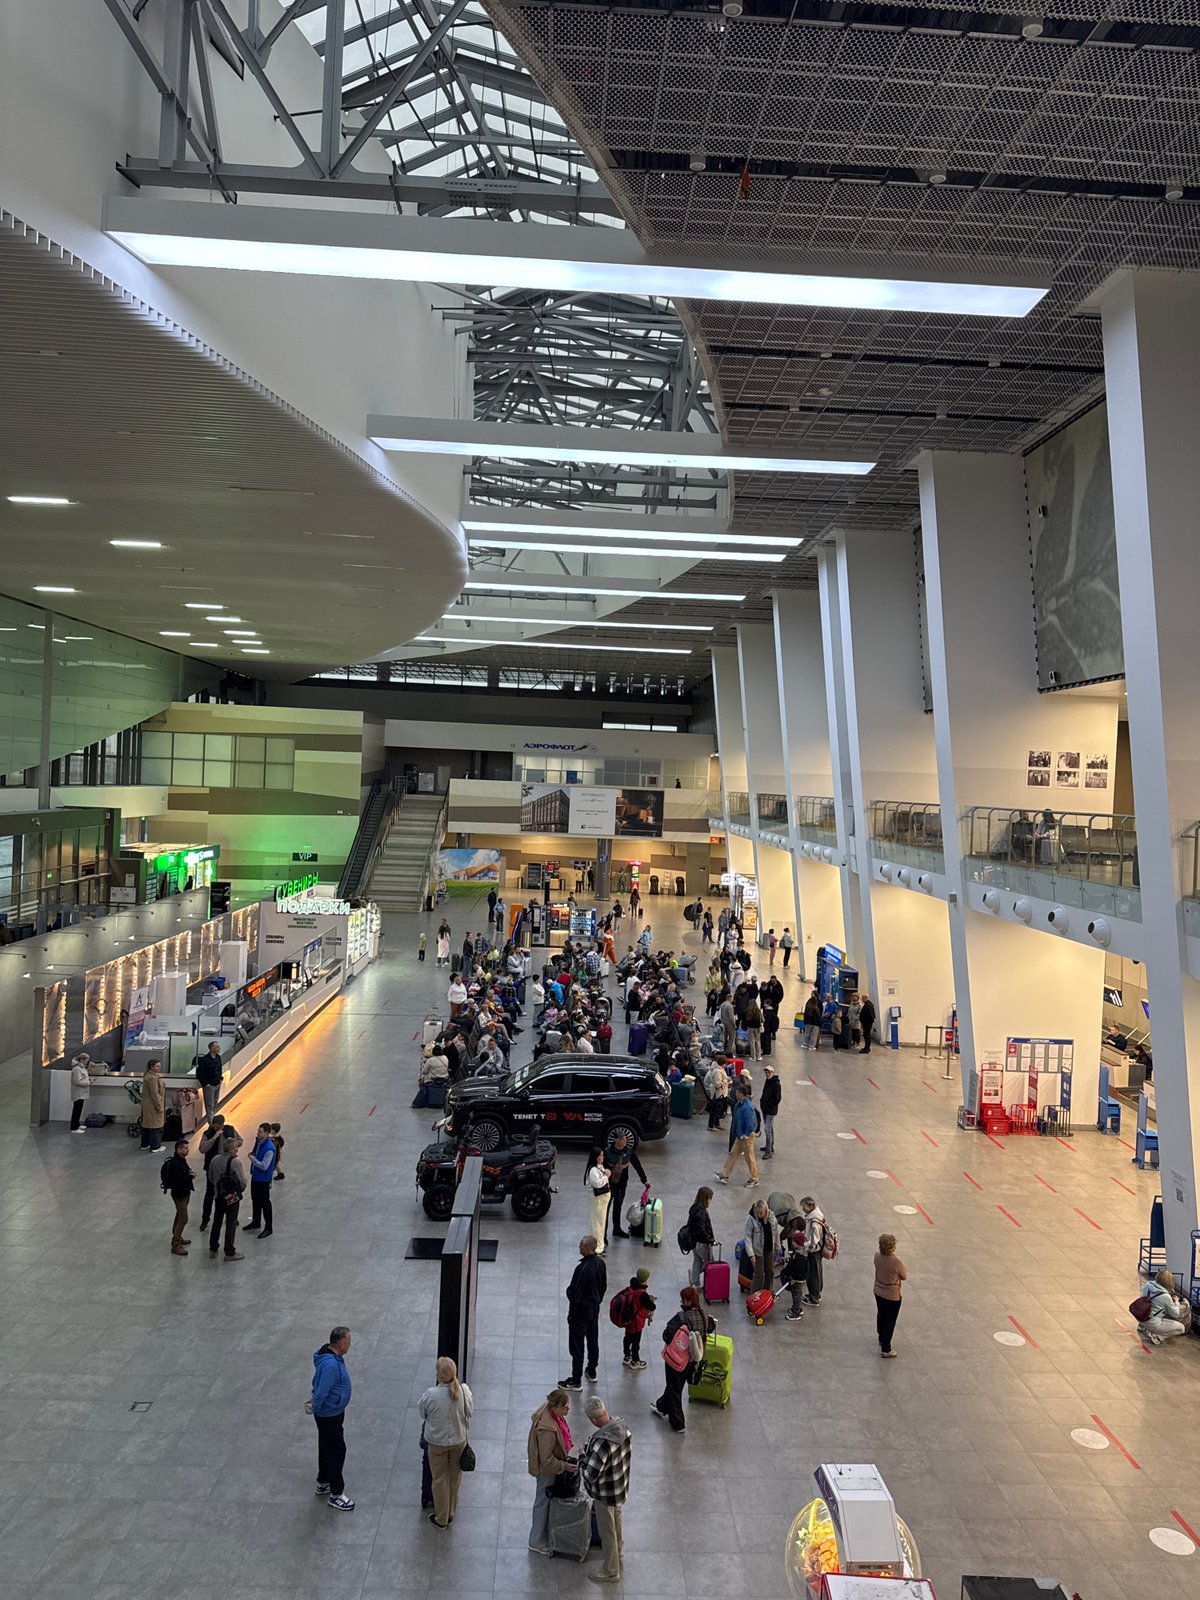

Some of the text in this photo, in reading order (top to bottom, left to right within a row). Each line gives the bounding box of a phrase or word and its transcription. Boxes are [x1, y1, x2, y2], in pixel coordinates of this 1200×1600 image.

[523, 742, 576, 751] АЭРОФЛОТ
[298, 852, 313, 860] VIP
[223, 885, 231, 897] 2
[275, 872, 319, 900] СУВЕНИРЫ
[276, 900, 351, 915] ПОДАРКИ
